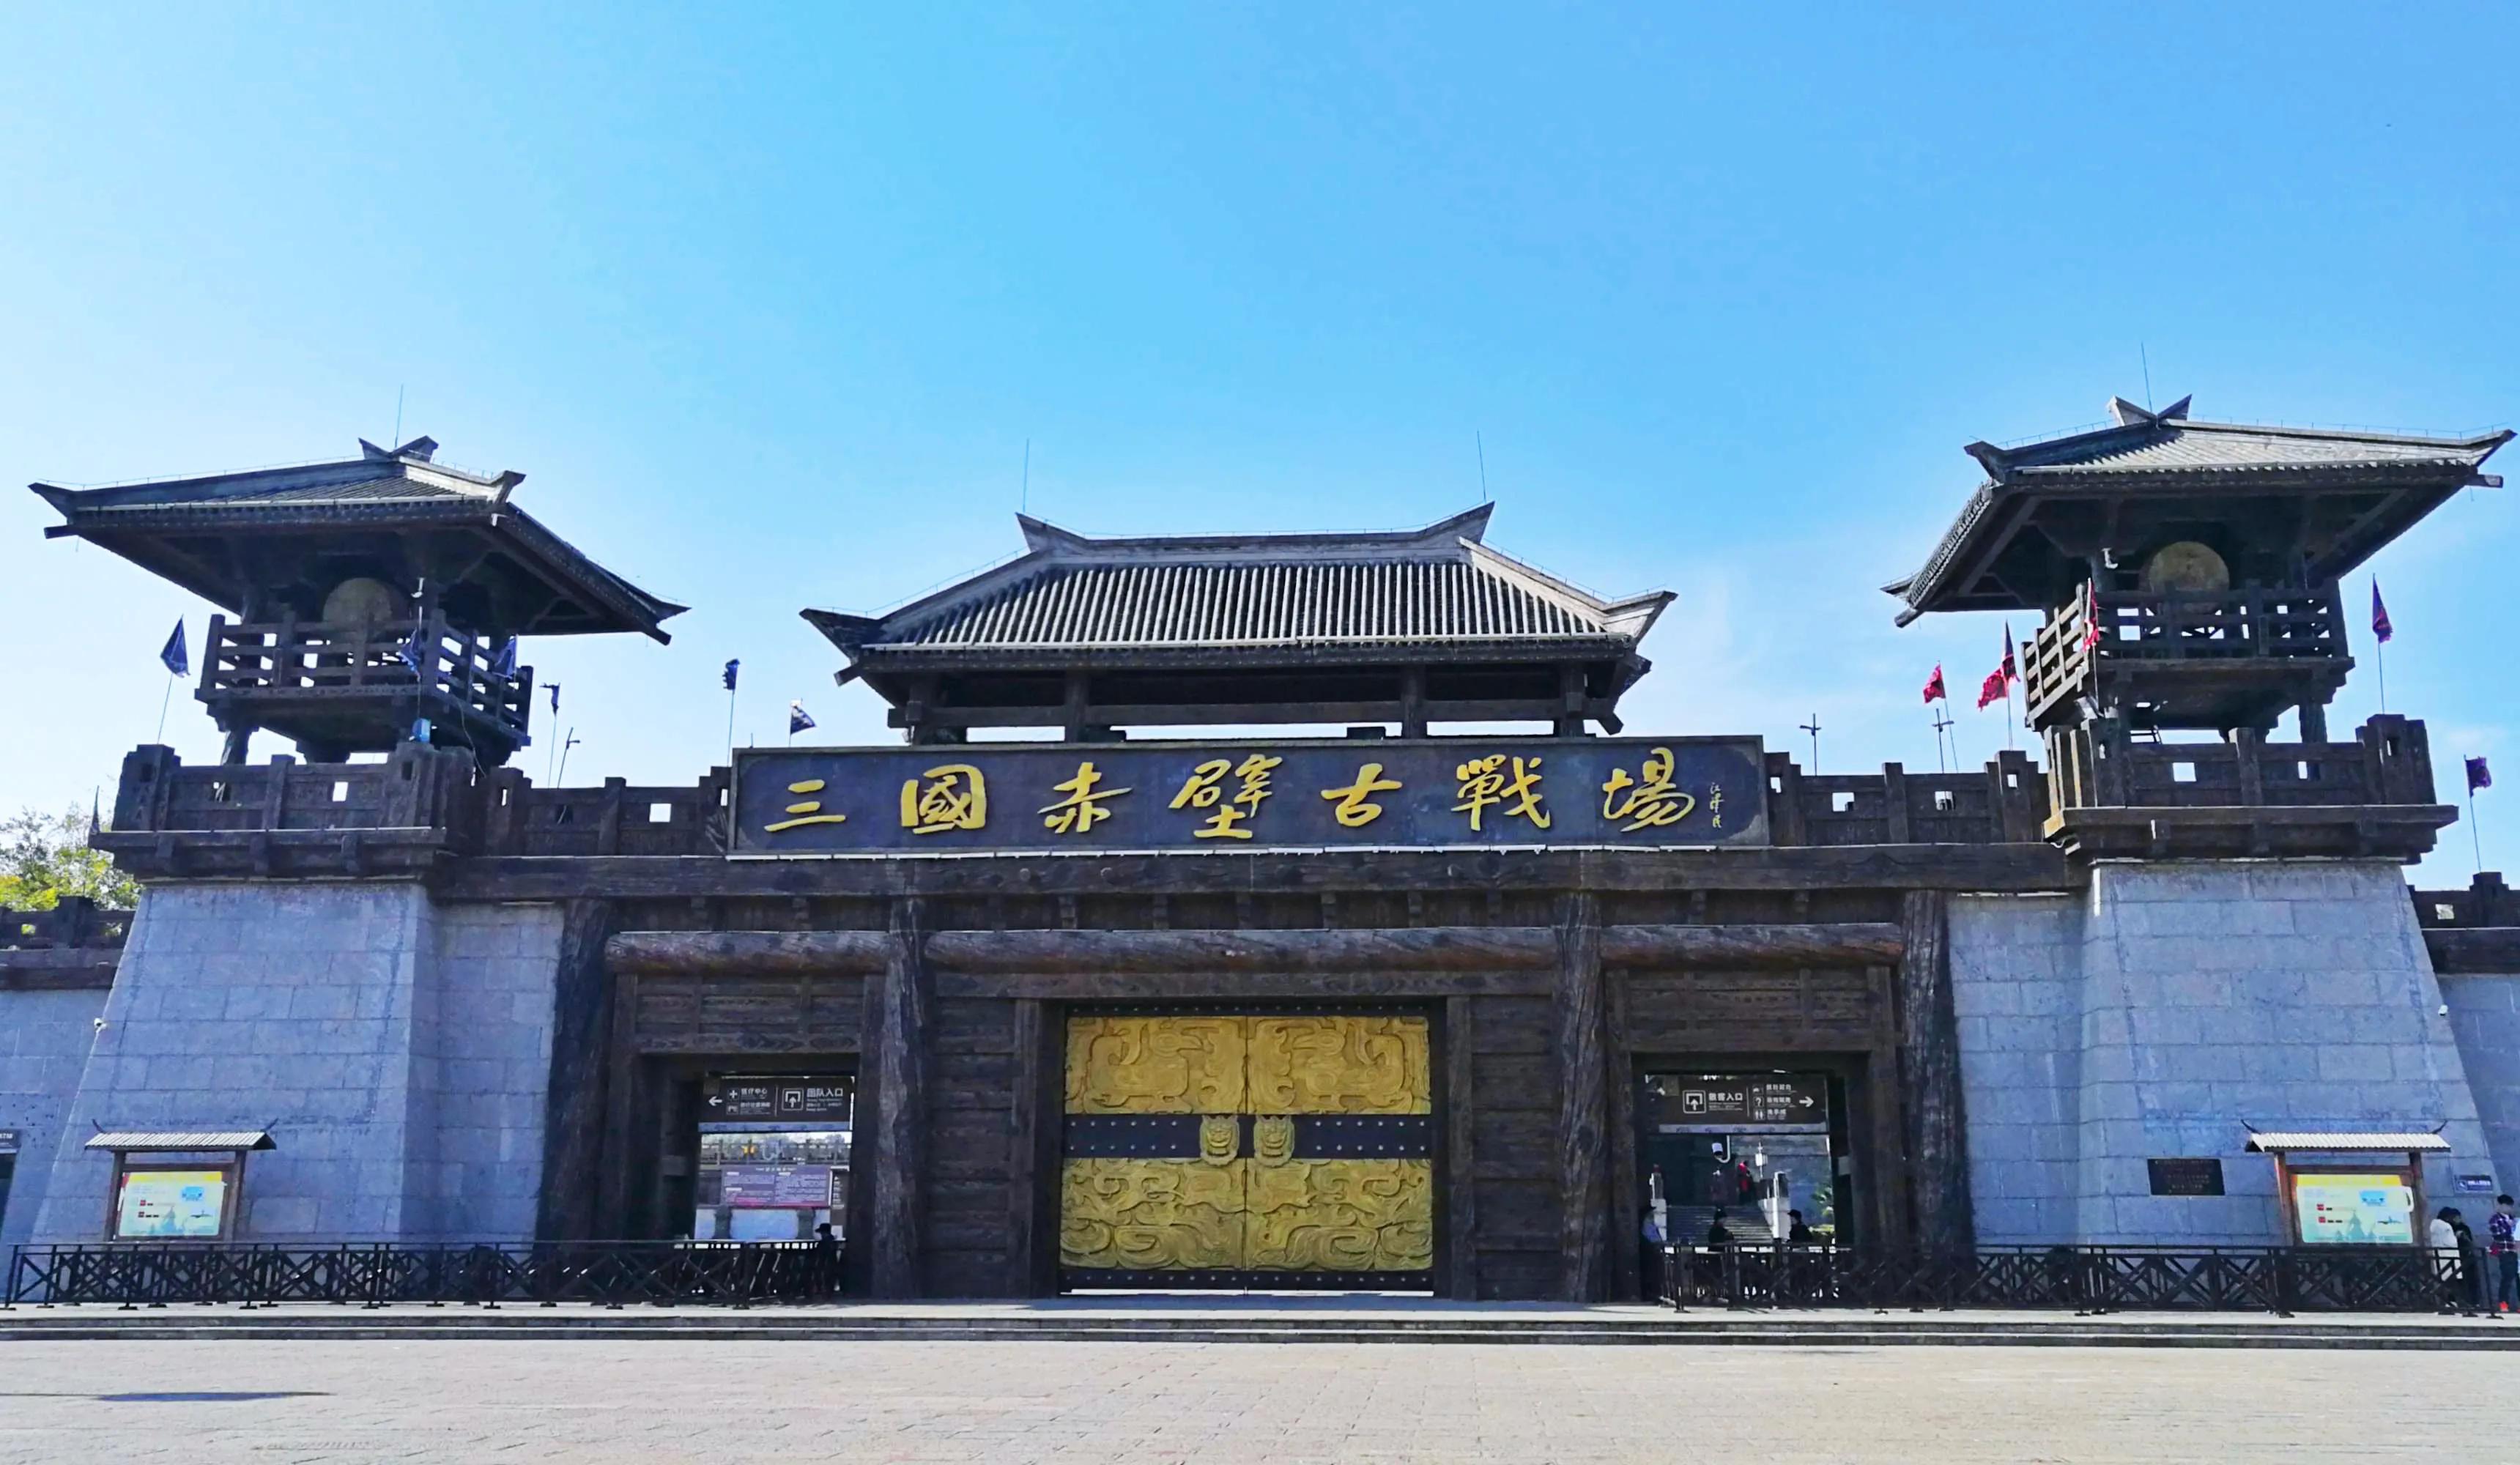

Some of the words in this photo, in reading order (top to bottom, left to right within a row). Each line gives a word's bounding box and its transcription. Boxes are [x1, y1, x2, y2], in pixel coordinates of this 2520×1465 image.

[764, 748, 1695, 839] 三國赤壁古戰場
[807, 1088, 843, 1098] 团队入口
